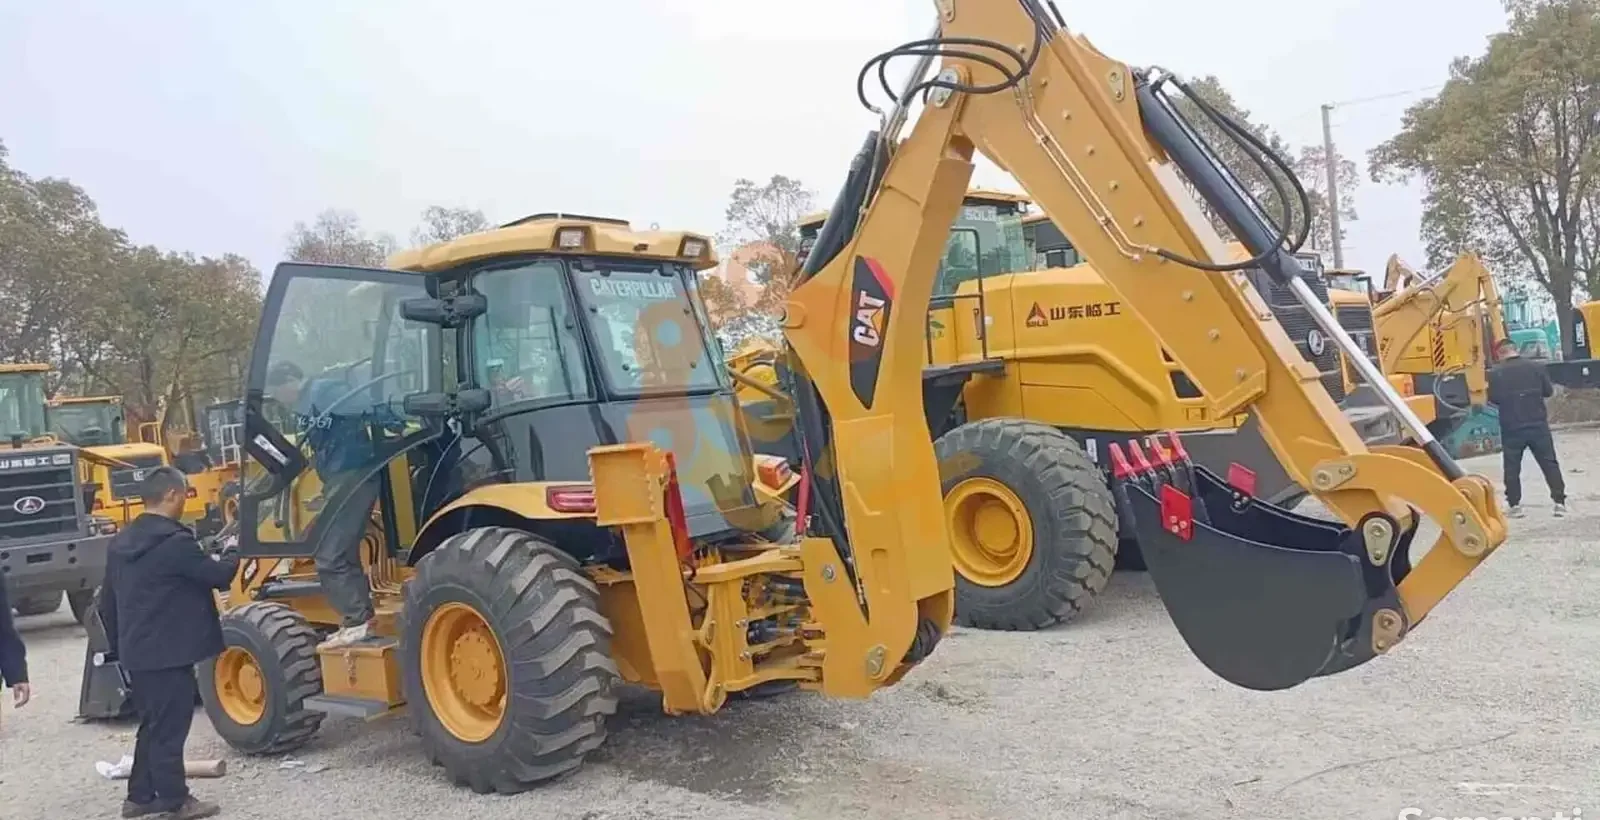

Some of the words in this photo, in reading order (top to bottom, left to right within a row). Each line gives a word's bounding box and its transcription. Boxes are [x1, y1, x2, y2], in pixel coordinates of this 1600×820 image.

[590, 278, 676, 299] CATERPILLAR
[853, 289, 886, 347] CAT
[1050, 301, 1121, 321] 山东临工
